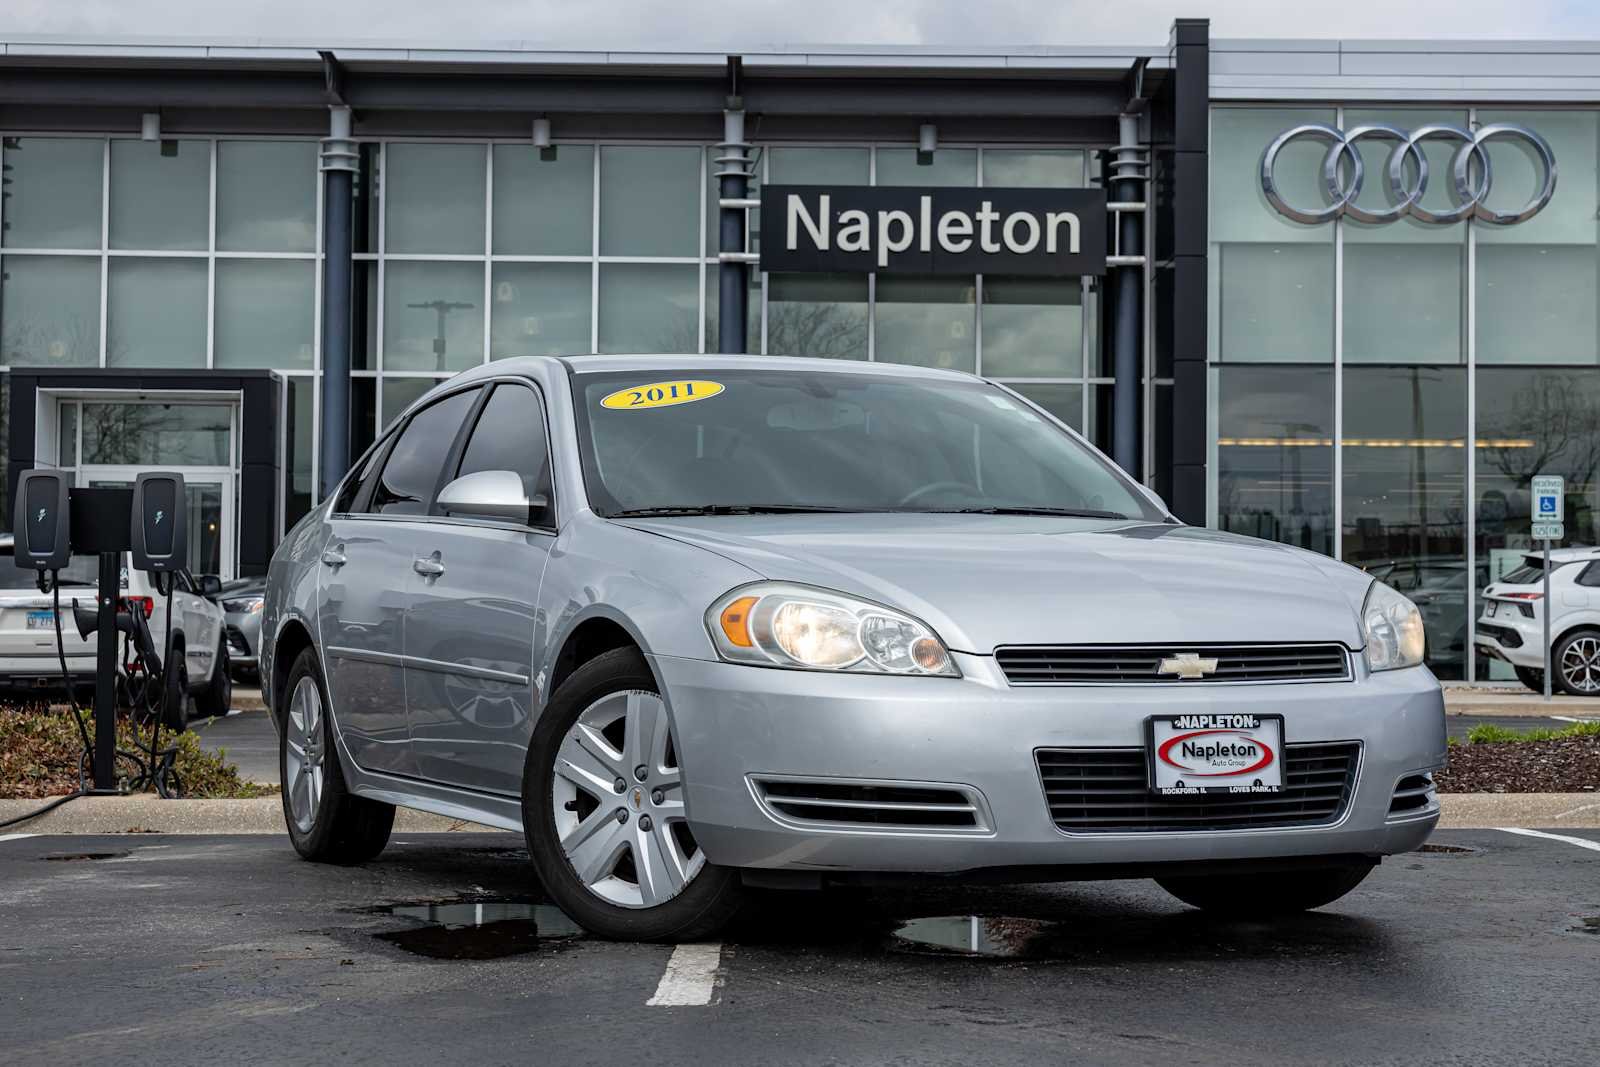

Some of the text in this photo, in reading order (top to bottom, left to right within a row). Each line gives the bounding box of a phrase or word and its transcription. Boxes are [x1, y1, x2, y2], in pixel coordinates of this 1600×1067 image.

[786, 193, 1081, 268] Napleton
[627, 383, 695, 405] 2011
[1180, 715, 1254, 728] NAPLETON
[1182, 742, 1257, 760] Napleton
[1228, 759, 1247, 767] Group
[1272, 785, 1279, 793] IL
